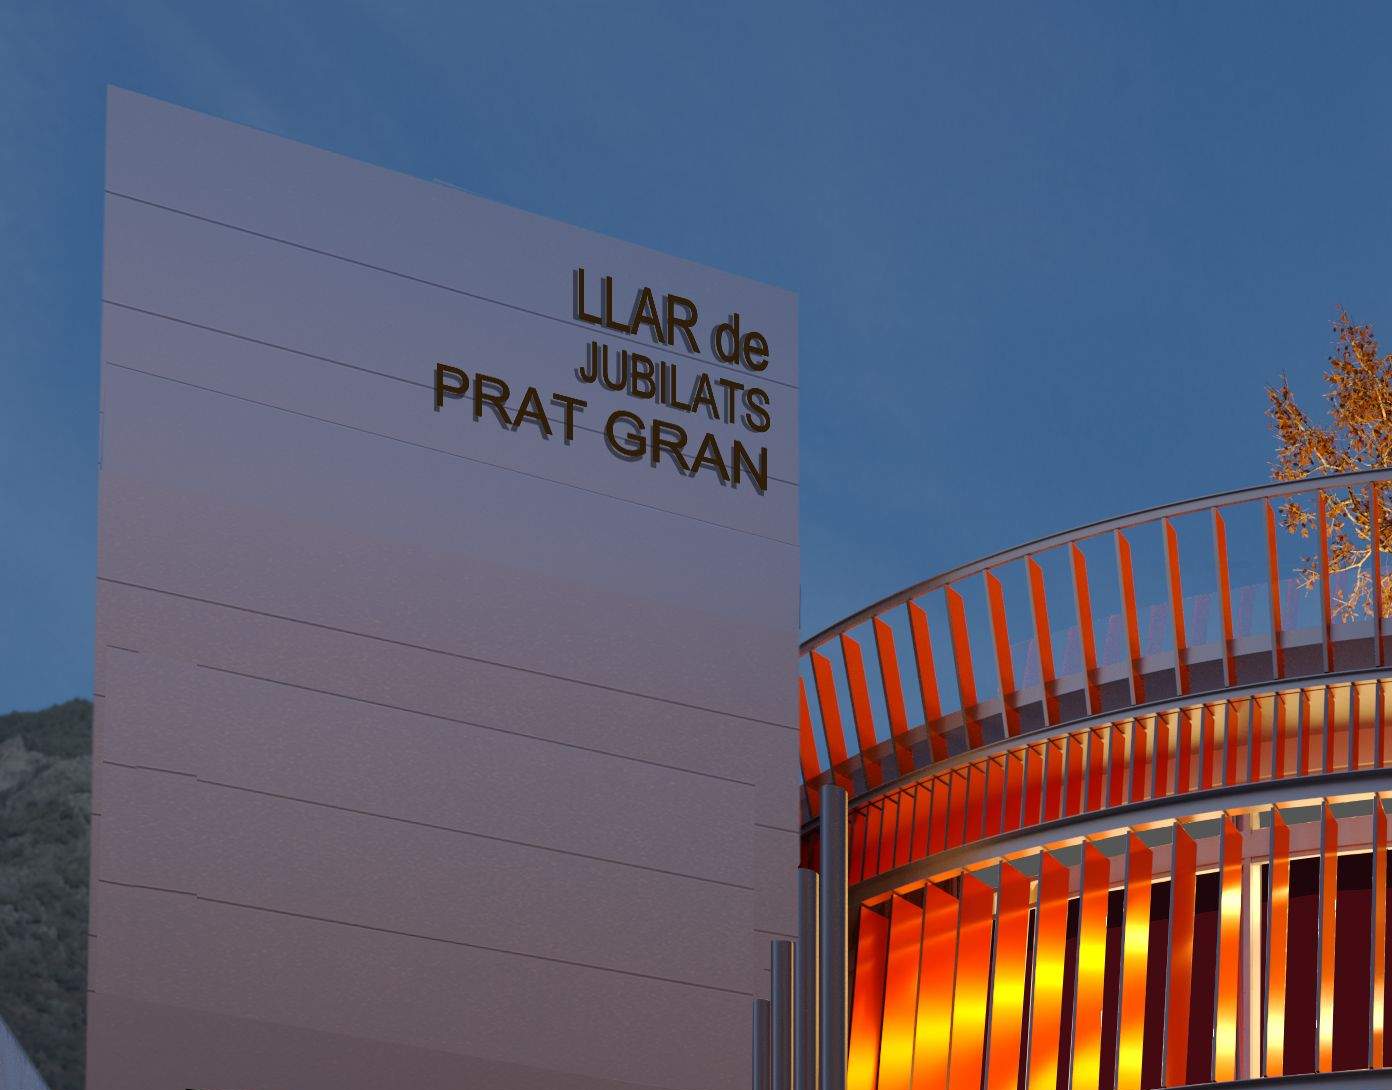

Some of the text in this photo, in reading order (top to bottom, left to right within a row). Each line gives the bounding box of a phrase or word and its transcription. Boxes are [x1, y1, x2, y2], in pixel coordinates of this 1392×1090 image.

[576, 267, 769, 372] LLAR de
[435, 362, 768, 493] PRAT GRAN
[577, 341, 771, 433] JUBILATS
